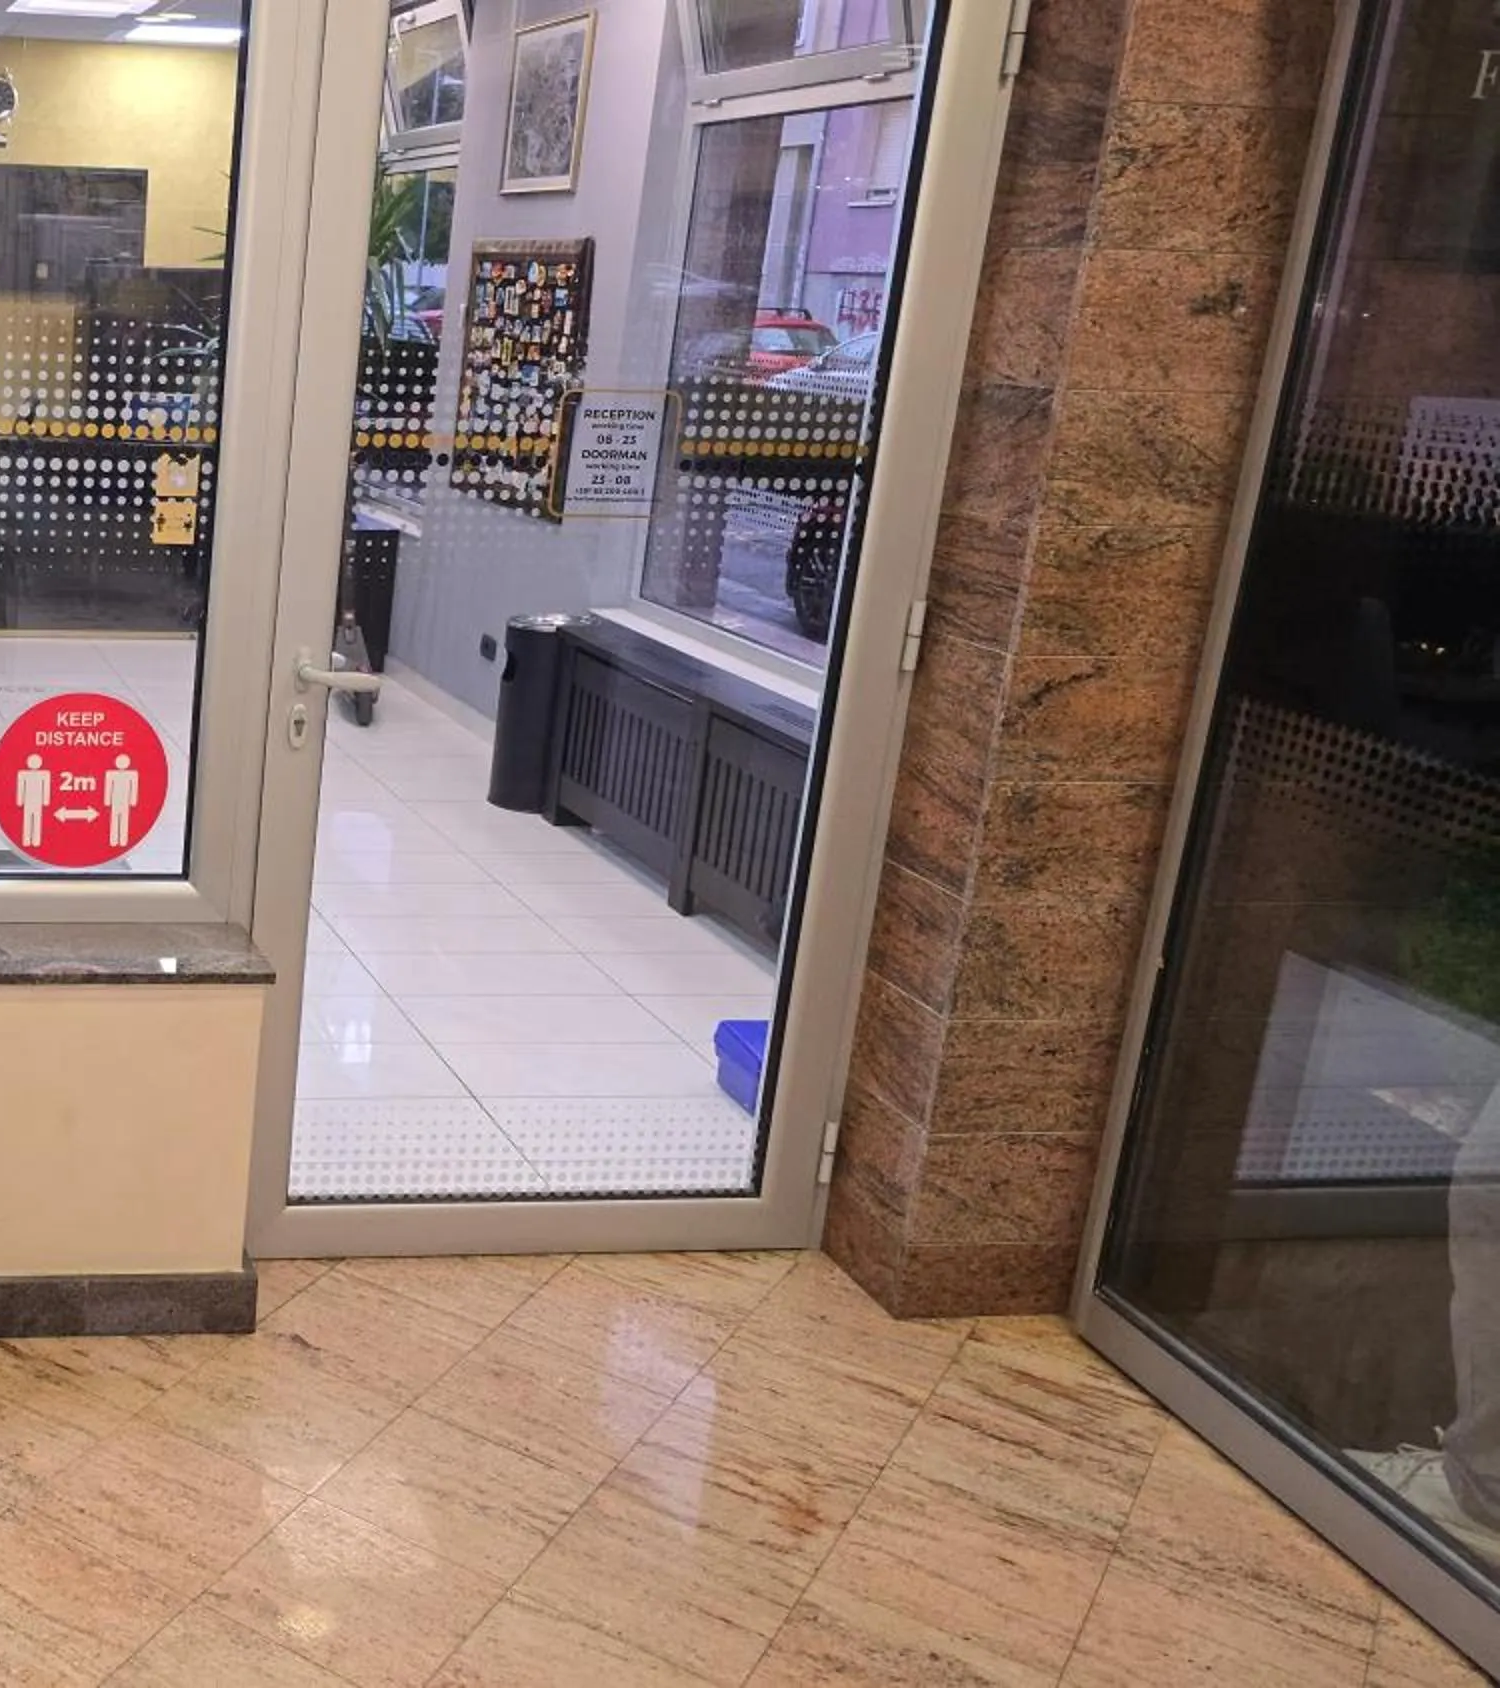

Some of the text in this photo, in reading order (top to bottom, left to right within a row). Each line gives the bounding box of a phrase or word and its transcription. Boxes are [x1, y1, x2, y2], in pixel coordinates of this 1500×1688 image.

[583, 408, 656, 421] RECEPTION
[622, 435, 637, 445] 23
[581, 449, 648, 461] DOORMAN
[56, 711, 105, 728] KEEP
[35, 731, 125, 747] DISTANCE
[59, 771, 97, 792] 2m
